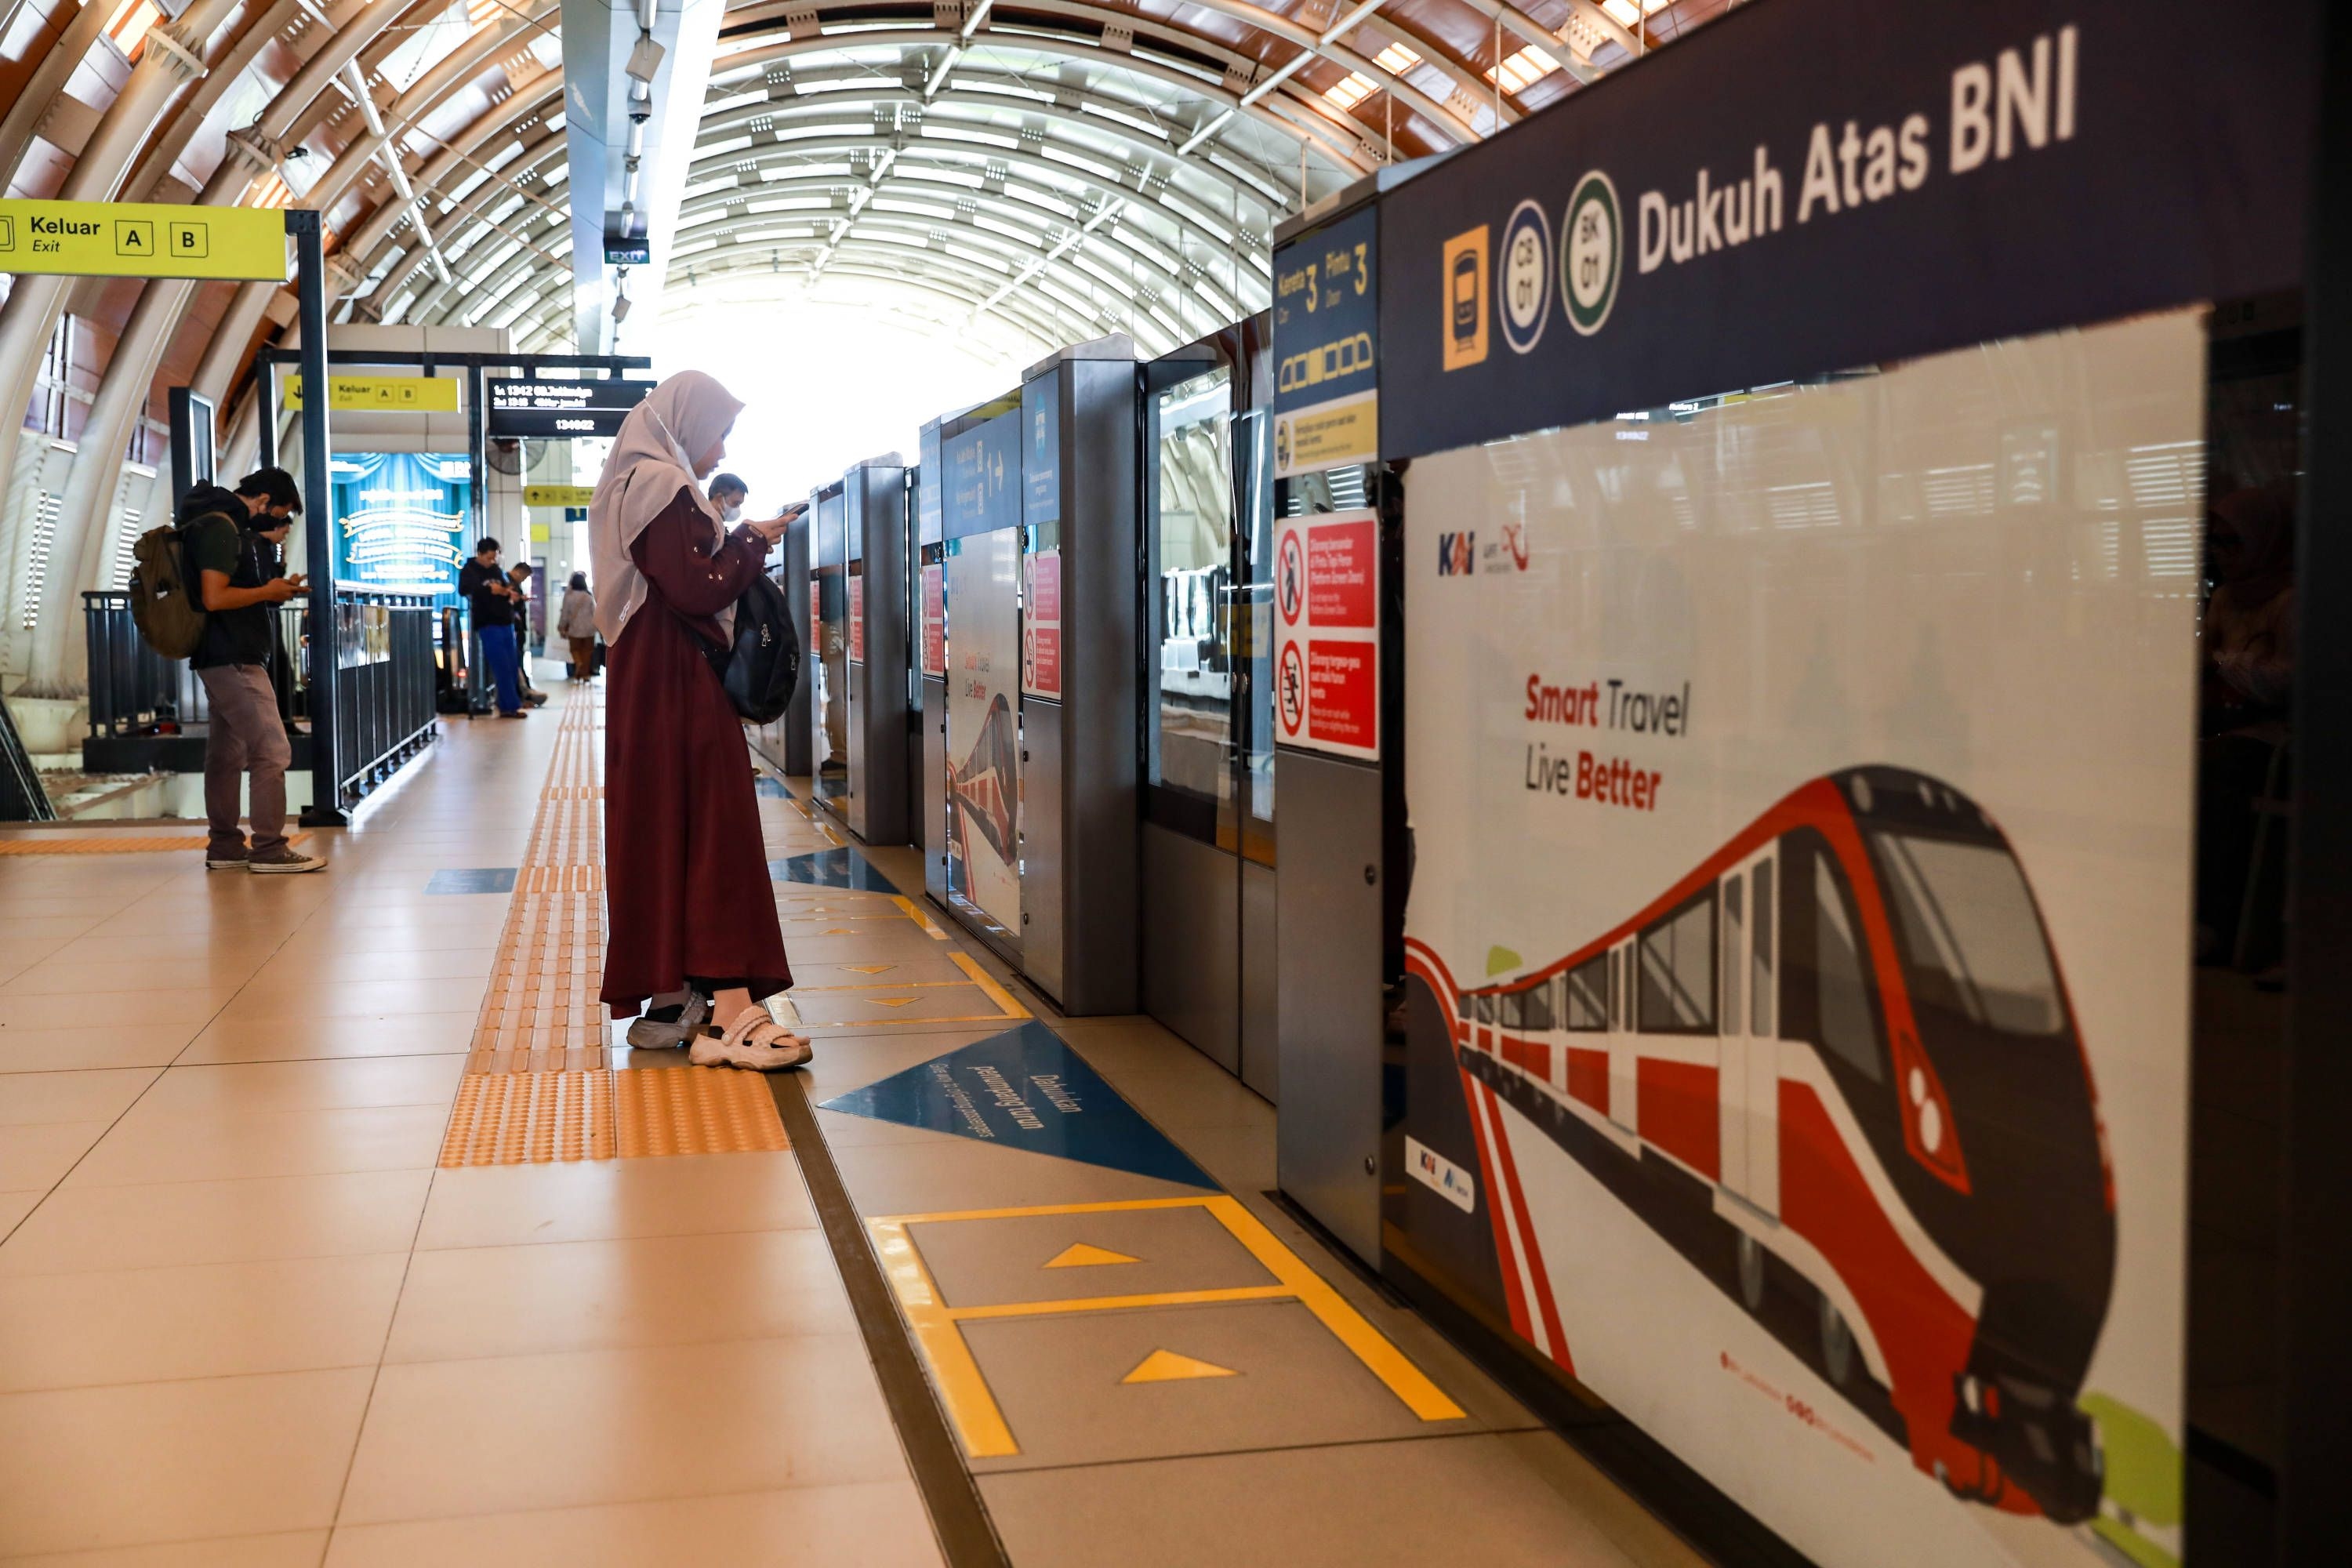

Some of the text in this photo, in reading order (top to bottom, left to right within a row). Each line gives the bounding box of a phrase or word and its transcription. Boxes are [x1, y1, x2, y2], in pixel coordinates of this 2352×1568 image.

[1639, 24, 2078, 274] Dukuh Atas BNI
[31, 216, 100, 236] Keluar
[125, 230, 142, 247] A
[182, 231, 195, 248] B
[1581, 210, 1600, 244] BK
[32, 240, 60, 252] Exit
[609, 250, 647, 261] EXIT
[1516, 237, 1534, 268] CB
[1355, 242, 1367, 296] 3
[1581, 252, 1600, 289] 01
[1306, 264, 1317, 313] 3
[1516, 278, 1534, 310] 01
[339, 385, 371, 394] Keluar
[404, 390, 412, 398] B
[1439, 531, 1475, 576] KAI
[1525, 673, 1690, 737] Smart Travel
[1526, 742, 1662, 812] Live Better
[966, 1066, 1045, 1130] penumpang turun
[1029, 1074, 1083, 1112] Dahulukan
